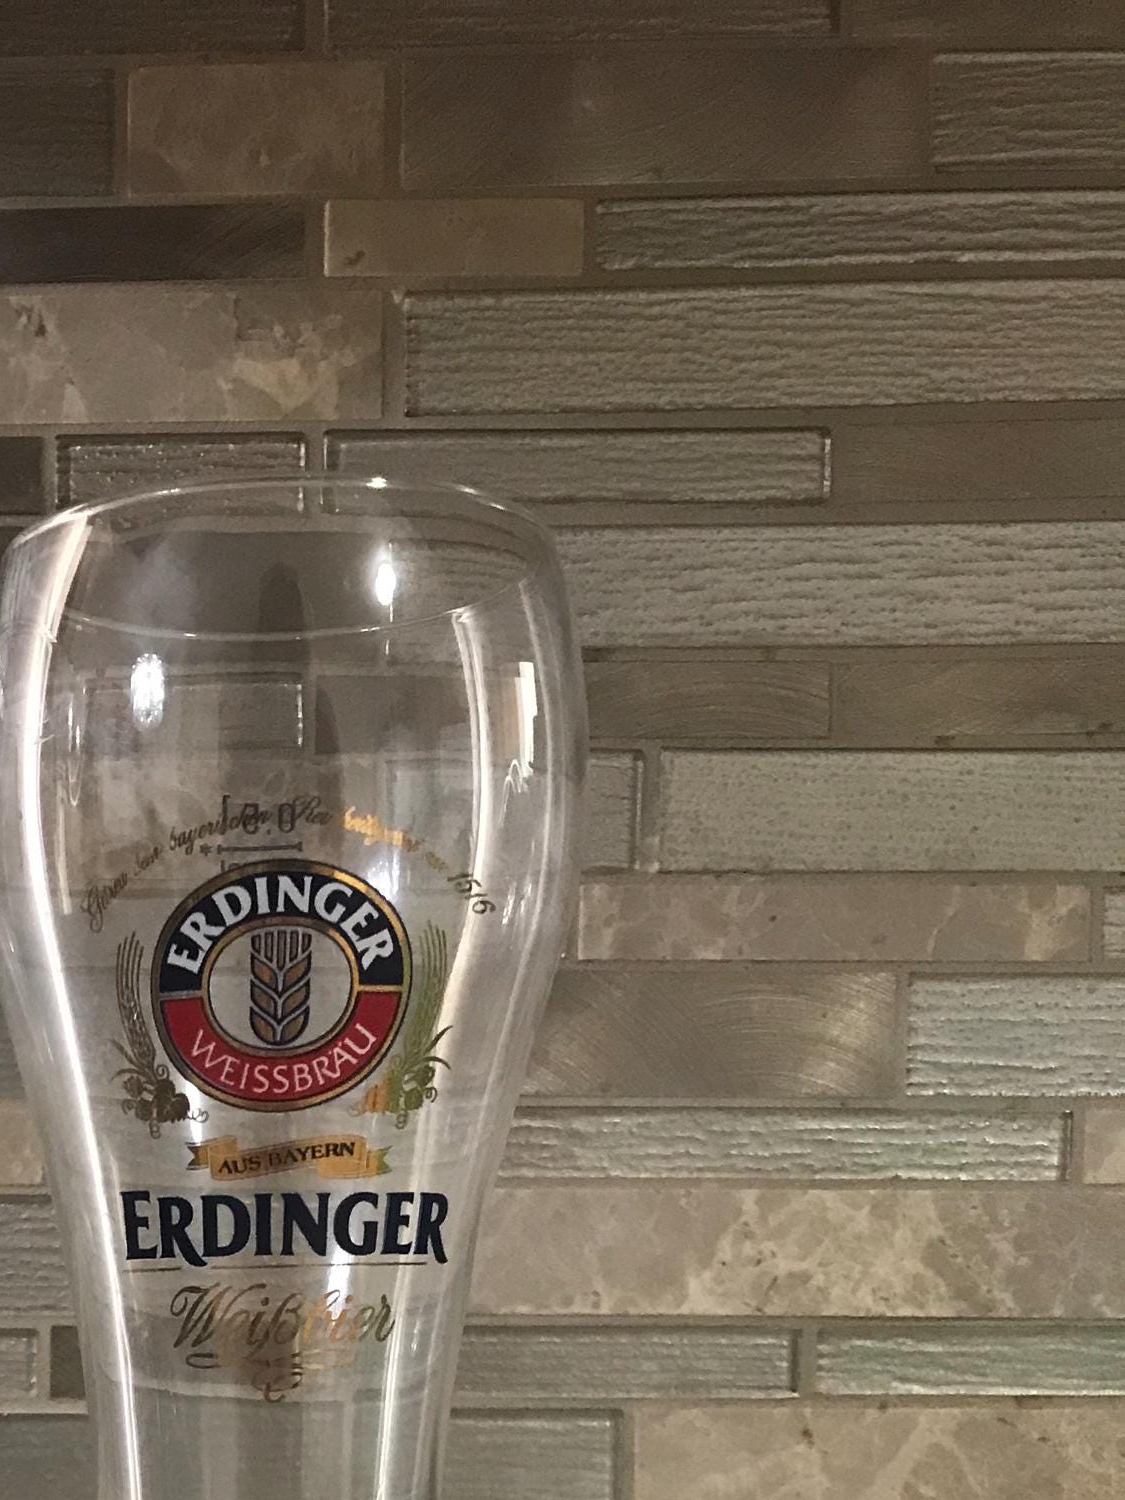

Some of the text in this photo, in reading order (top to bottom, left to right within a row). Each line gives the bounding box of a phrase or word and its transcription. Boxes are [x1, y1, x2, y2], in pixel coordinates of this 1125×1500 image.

[167, 874, 395, 974] ERDINGER
[191, 1021, 379, 1094] WEISSBRÄU
[218, 1141, 356, 1175] AUS BAYERN
[120, 1190, 449, 1267] ERDINGER
